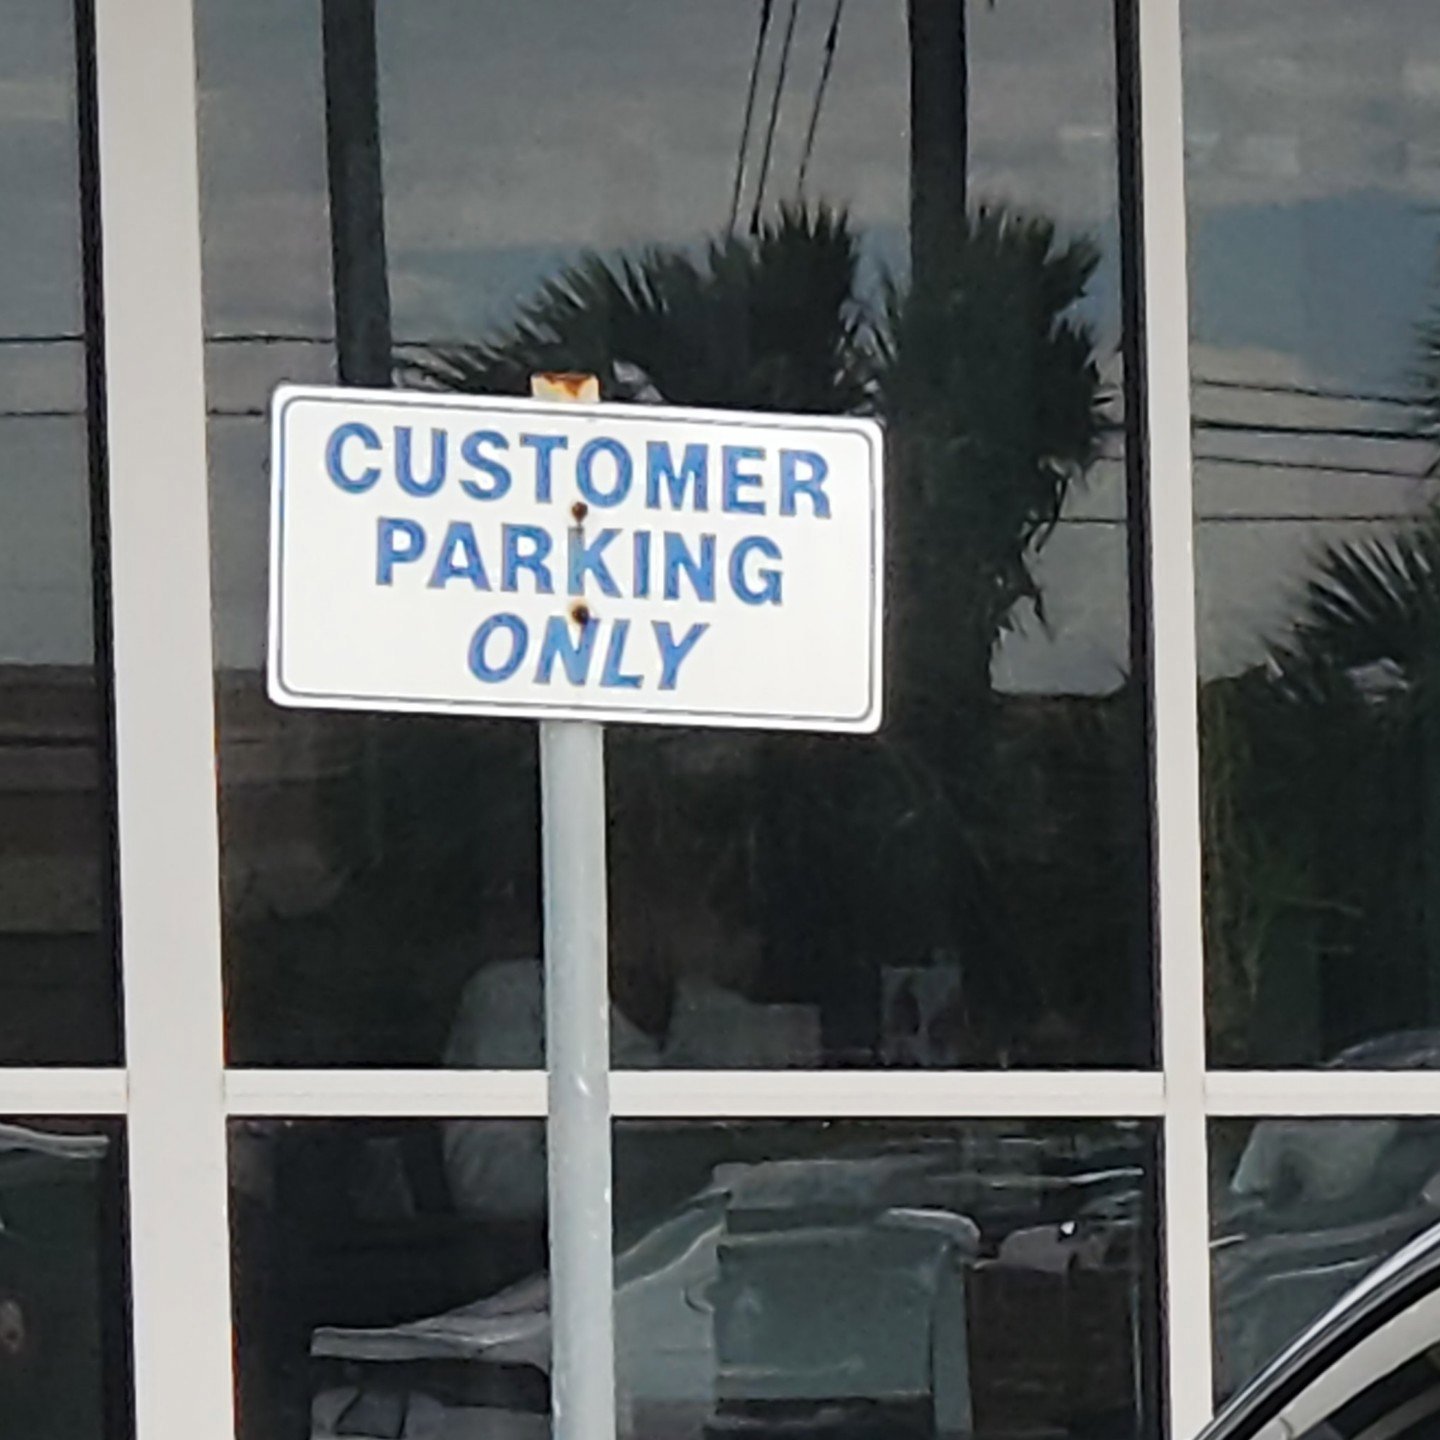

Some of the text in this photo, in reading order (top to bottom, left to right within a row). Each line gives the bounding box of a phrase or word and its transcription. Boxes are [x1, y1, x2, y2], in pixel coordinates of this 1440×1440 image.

[325, 421, 832, 519] CUSTOMER
[375, 516, 784, 605] PARKING
[467, 612, 711, 691] ONLY
